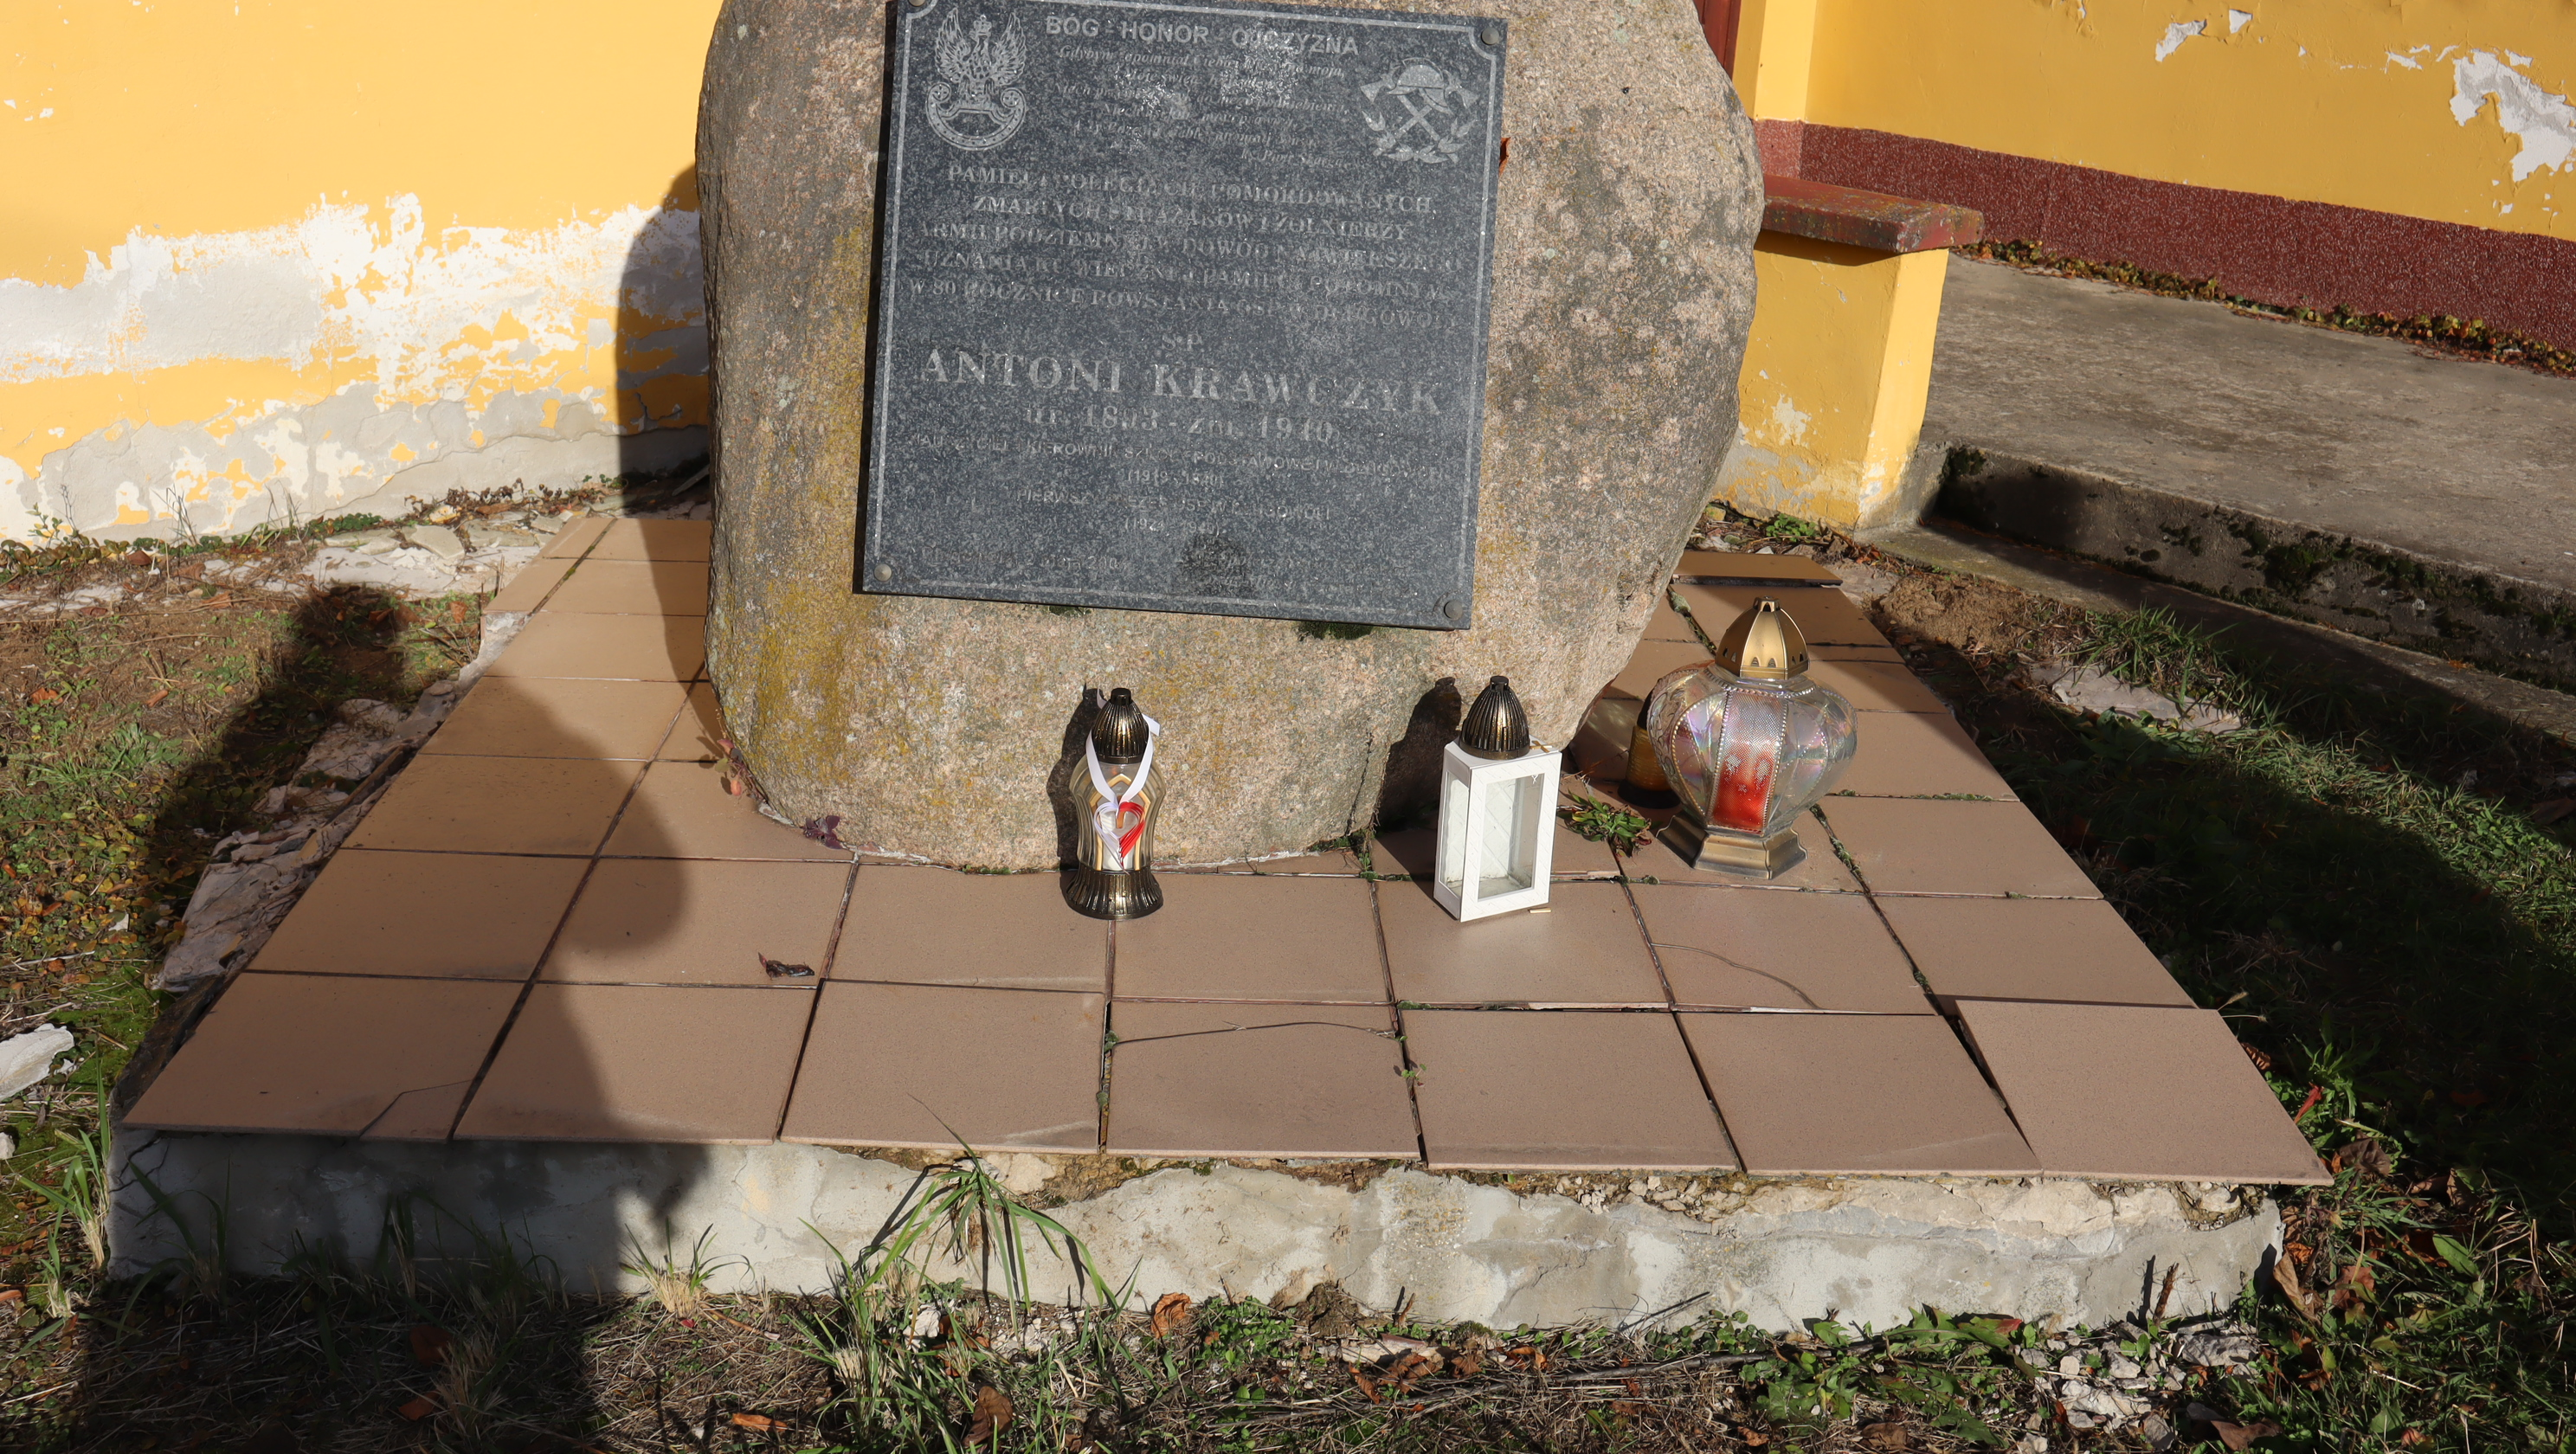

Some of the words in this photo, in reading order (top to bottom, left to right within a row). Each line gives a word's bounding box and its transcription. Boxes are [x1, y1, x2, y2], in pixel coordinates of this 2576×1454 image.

[1045, 11, 1101, 37] BÓG
[1120, 21, 1209, 44] HONOR
[1230, 28, 1360, 55] OJCZYZNA
[1117, 50, 1190, 68] apomniał
[933, 280, 957, 296] 80
[919, 346, 1124, 394] ANTONI
[1151, 363, 1442, 415] KRAWCZYK
